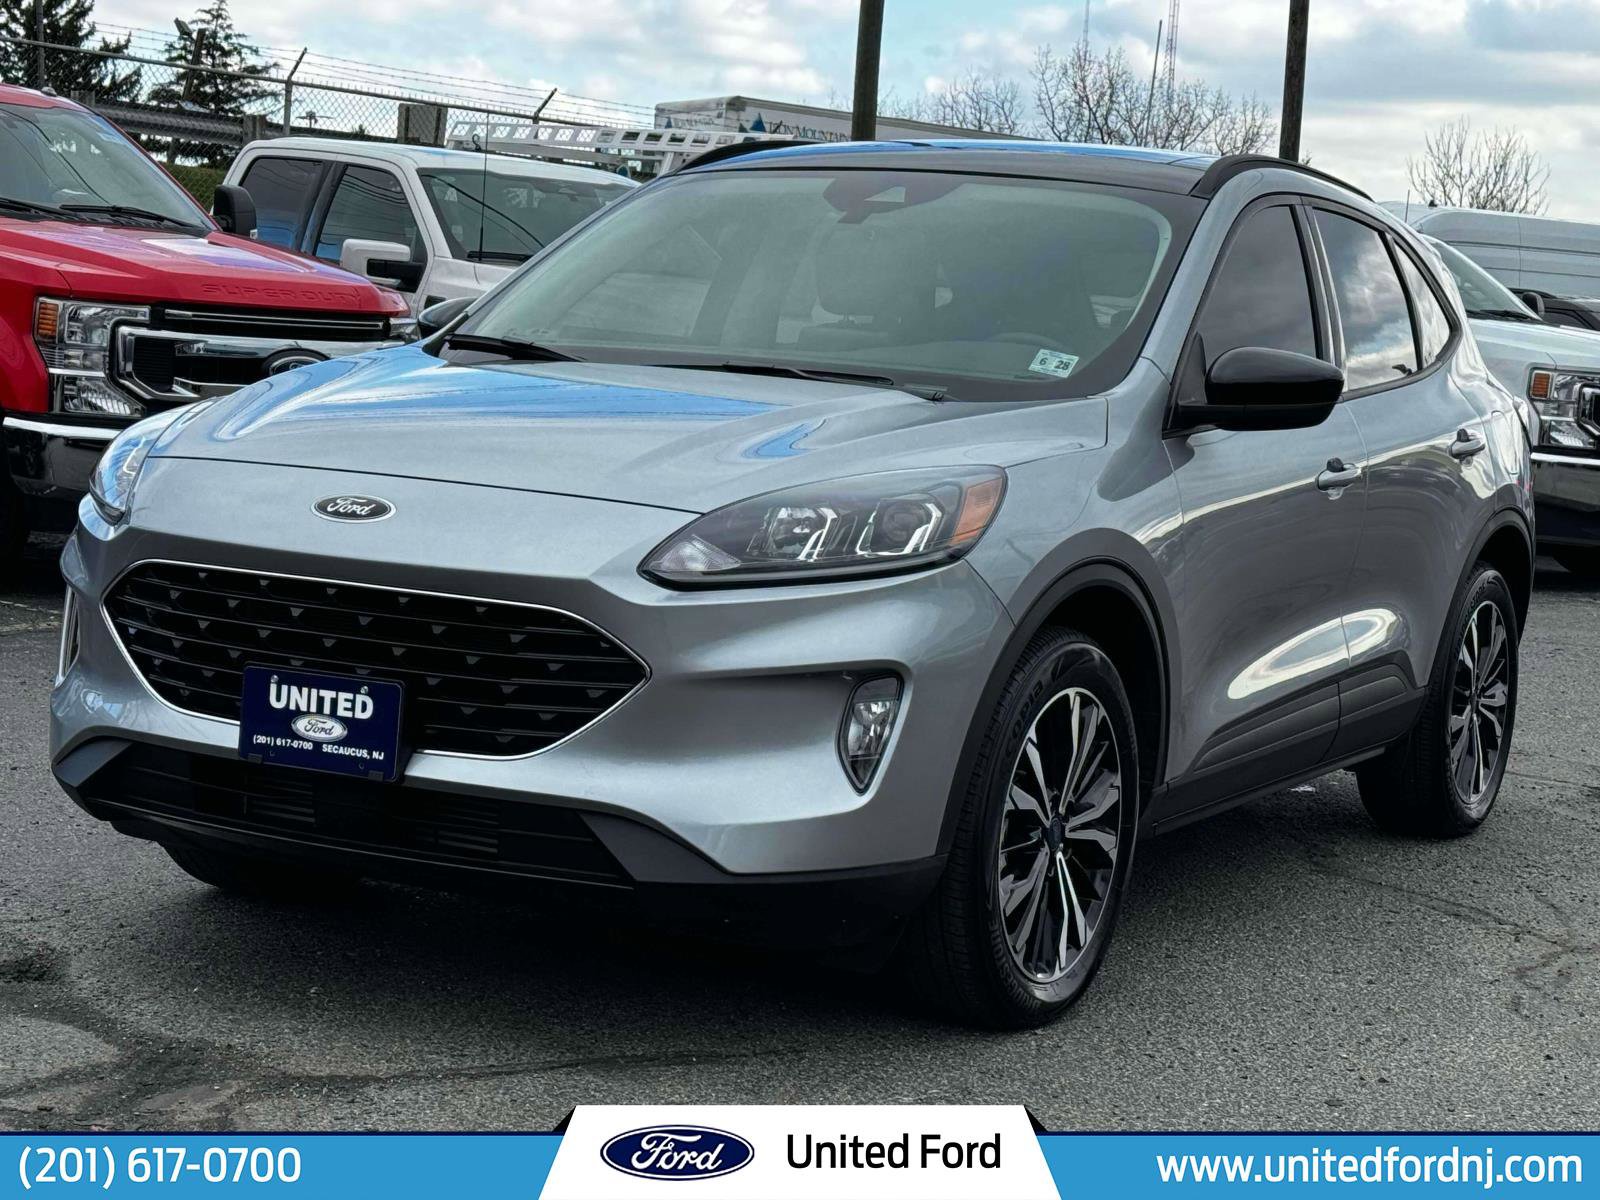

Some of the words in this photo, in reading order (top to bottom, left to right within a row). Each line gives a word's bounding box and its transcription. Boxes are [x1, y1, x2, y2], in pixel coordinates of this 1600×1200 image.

[201, 283, 297, 300] SUPER
[302, 289, 361, 305] DUTY
[1039, 357, 1049, 366] 6
[1054, 360, 1071, 371] 28
[326, 497, 377, 516] Ford
[269, 682, 374, 720] UNITED
[303, 719, 335, 737] Ford
[253, 735, 275, 747] (201)
[276, 737, 314, 751] 617-0700
[322, 743, 371, 760] SECAUCUS,
[372, 750, 385, 761] NJ
